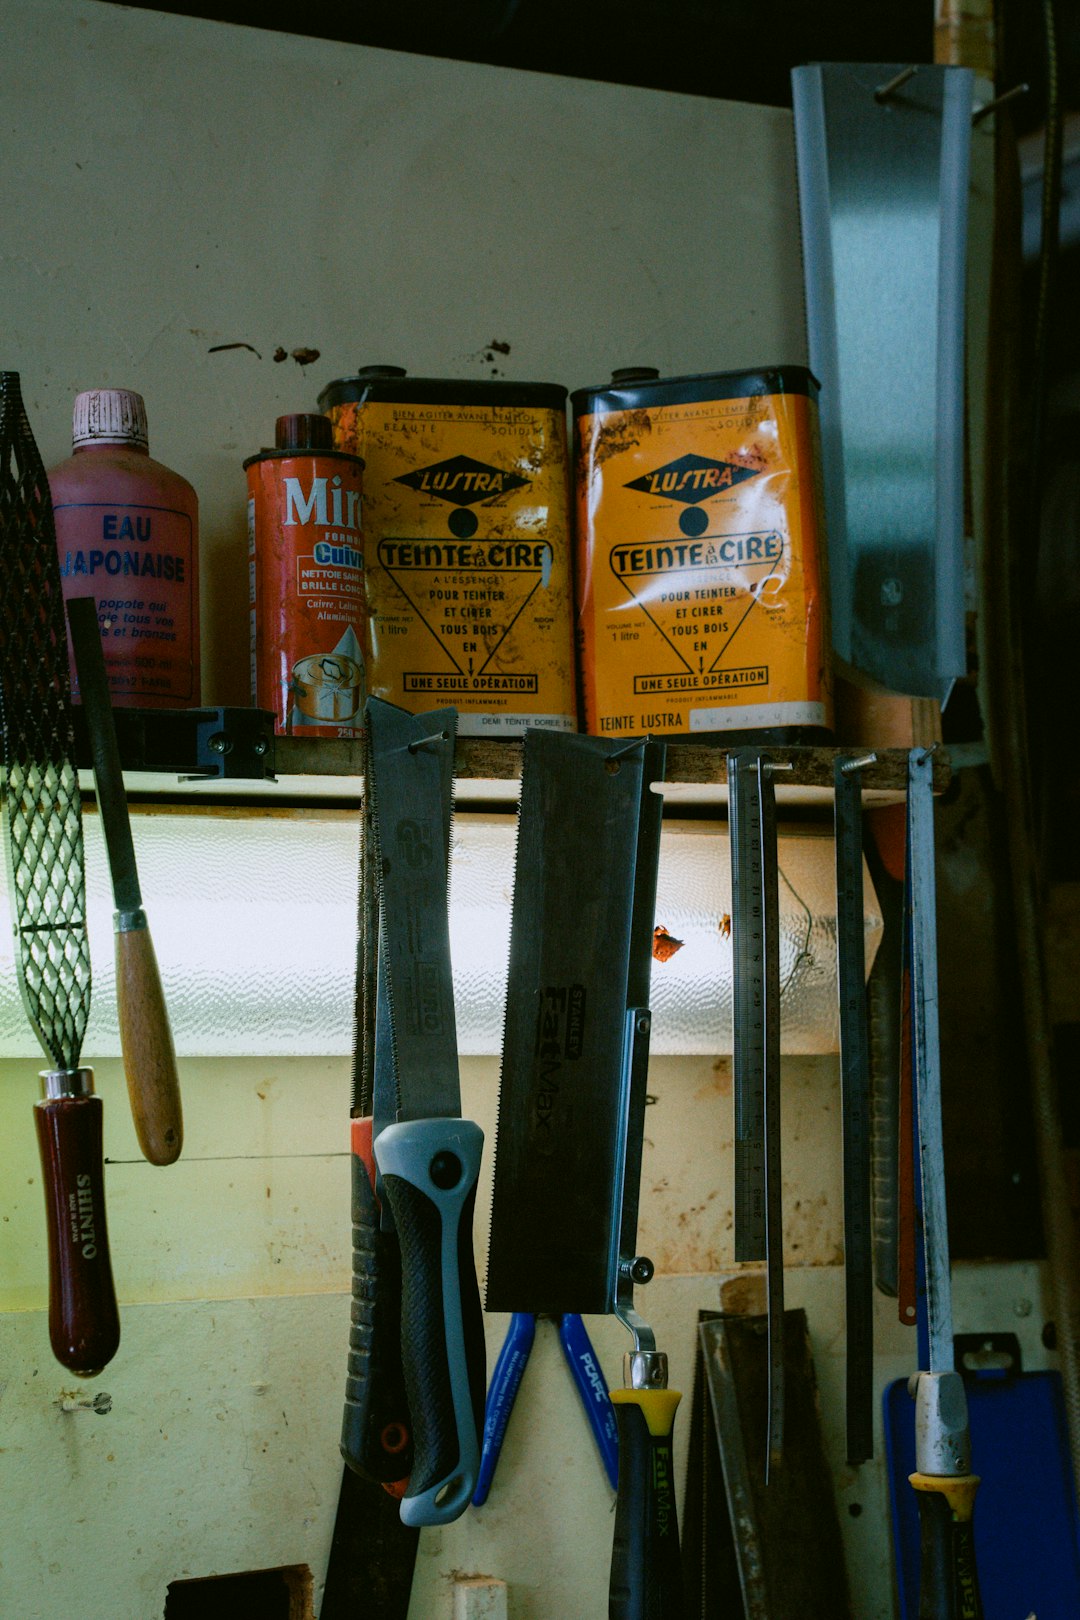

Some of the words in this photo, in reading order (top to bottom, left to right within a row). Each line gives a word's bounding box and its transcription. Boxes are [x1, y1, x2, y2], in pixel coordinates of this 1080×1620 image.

[419, 410, 453, 419] AGITER
[103, 515, 151, 541] EAU
[313, 541, 364, 571] Cuivr
[382, 544, 471, 566] TEINTE
[488, 544, 546, 566] CIRE
[614, 543, 702, 572] TEINTE
[720, 535, 777, 562] CIRE
[60, 550, 185, 583] JAPONAISE
[302, 570, 341, 579] NETTOIE
[302, 581, 337, 591] BRILLE
[429, 590, 458, 600] POUR
[463, 590, 505, 600] TEINTER
[661, 591, 690, 602] POUR
[695, 587, 736, 600] TEINTER
[99, 599, 144, 611] popote
[149, 602, 166, 612] qui
[444, 608, 456, 617] ET
[460, 608, 491, 618] CIRER
[676, 609, 687, 619] ET
[692, 606, 723, 617] CIRER
[124, 614, 150, 624] tous
[155, 617, 174, 626] vos
[114, 628, 126, 636] et
[131, 627, 176, 640] bronzes
[380, 625, 385, 634] 1
[388, 624, 408, 635] litre
[440, 625, 467, 635] TOUS
[473, 625, 498, 635] BOIS
[672, 626, 698, 636] TOUS
[704, 622, 729, 634] BOIS
[612, 633, 617, 641] 1
[620, 631, 639, 641] litre
[463, 642, 477, 652] EN
[694, 642, 708, 652] EN
[411, 678, 433, 688] UNE
[437, 678, 469, 688] SEULE
[473, 677, 533, 689] OPÉRATION
[641, 679, 663, 690] UNE
[667, 675, 699, 688] SEULE
[703, 670, 765, 685] OPÉRATION
[600, 716, 634, 732] TEINTE
[641, 713, 683, 728] LUSTRA
[337, 728, 353, 737] 250
[570, 988, 583, 1055] STANLEY
[77, 1174, 97, 1260] SHINTO
